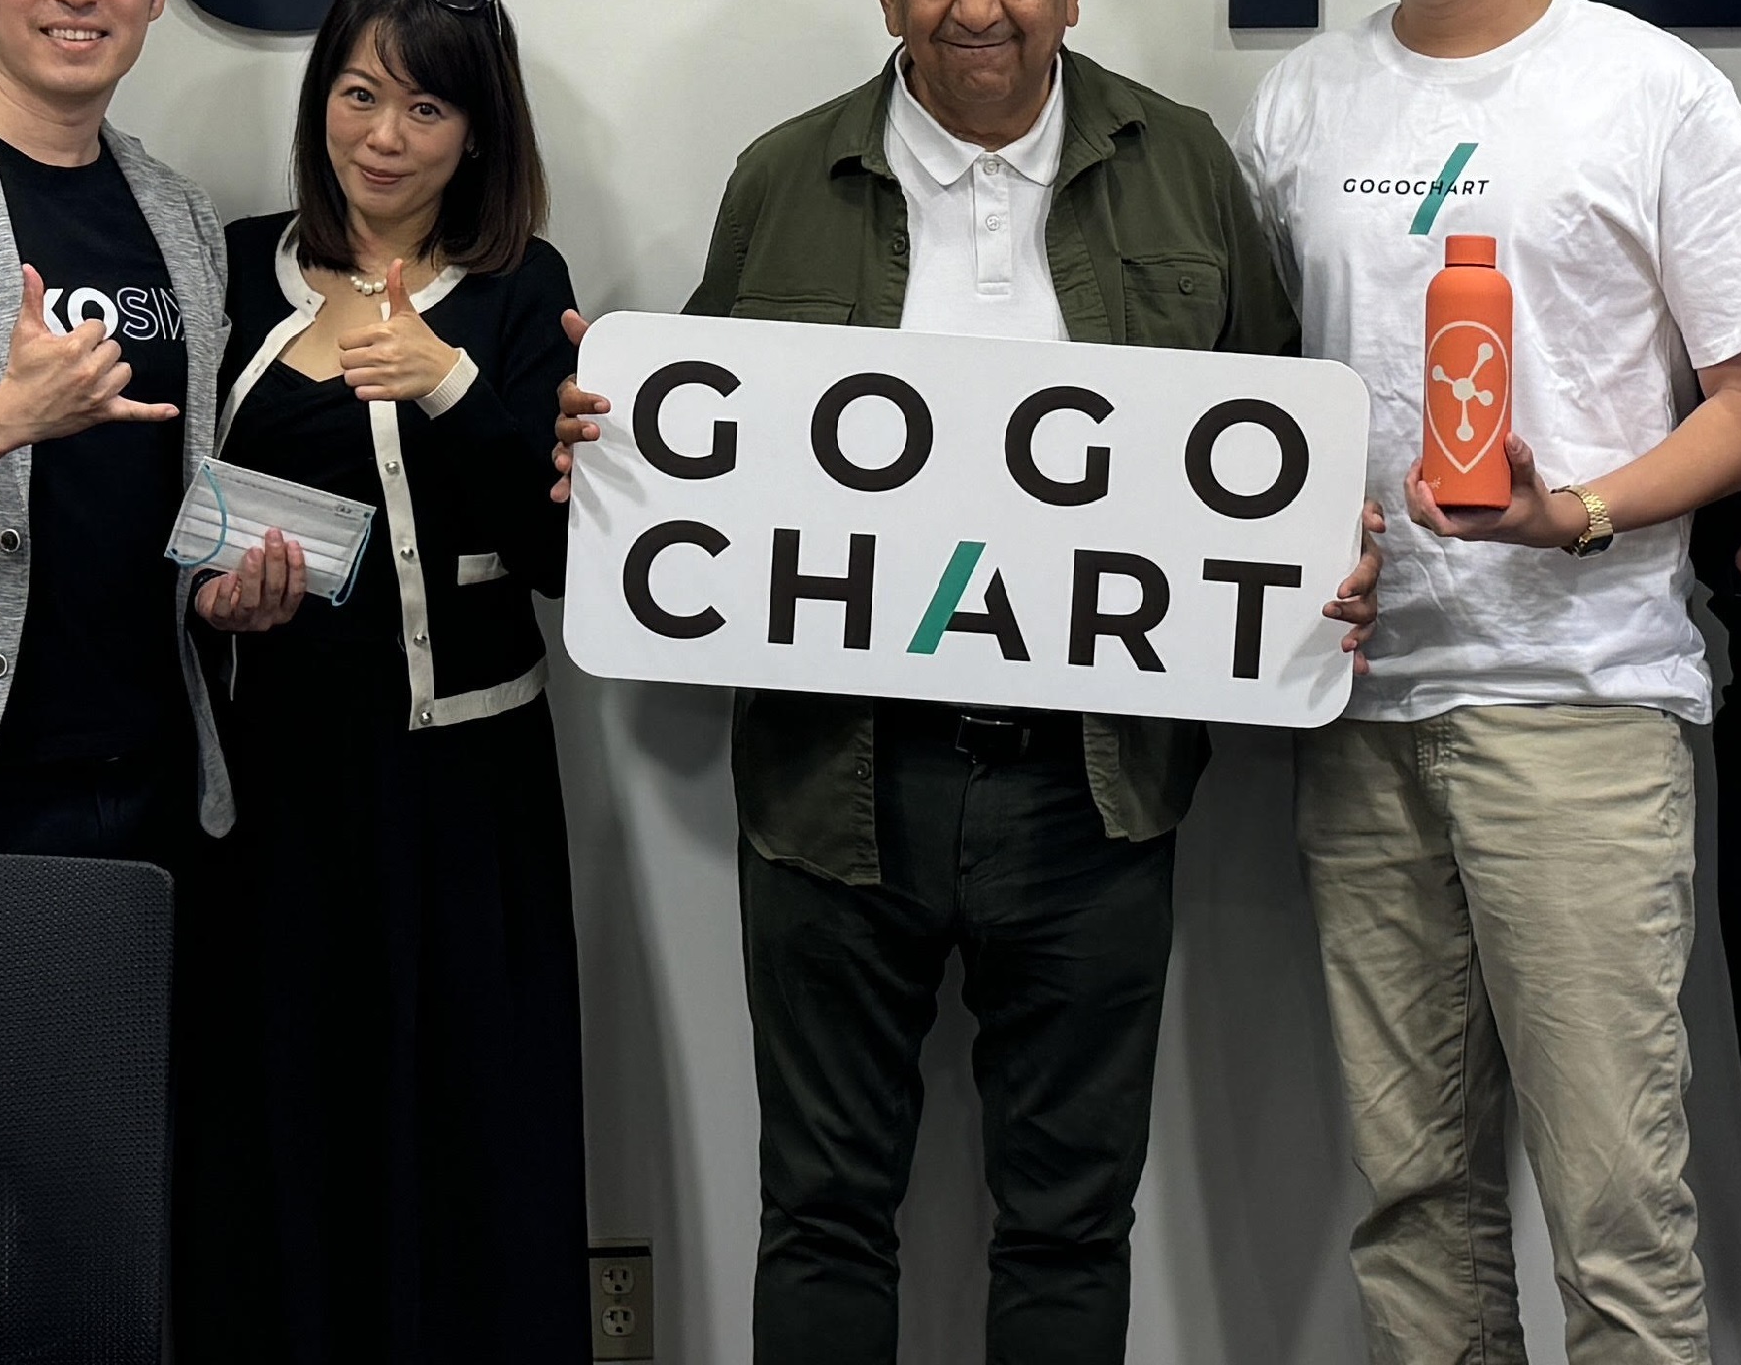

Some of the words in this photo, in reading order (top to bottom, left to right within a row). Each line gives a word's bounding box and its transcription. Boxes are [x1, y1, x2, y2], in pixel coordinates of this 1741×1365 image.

[1343, 178, 1490, 196] GOGOCHART
[632, 360, 1310, 521] GOGO
[622, 519, 1303, 680] CHART
